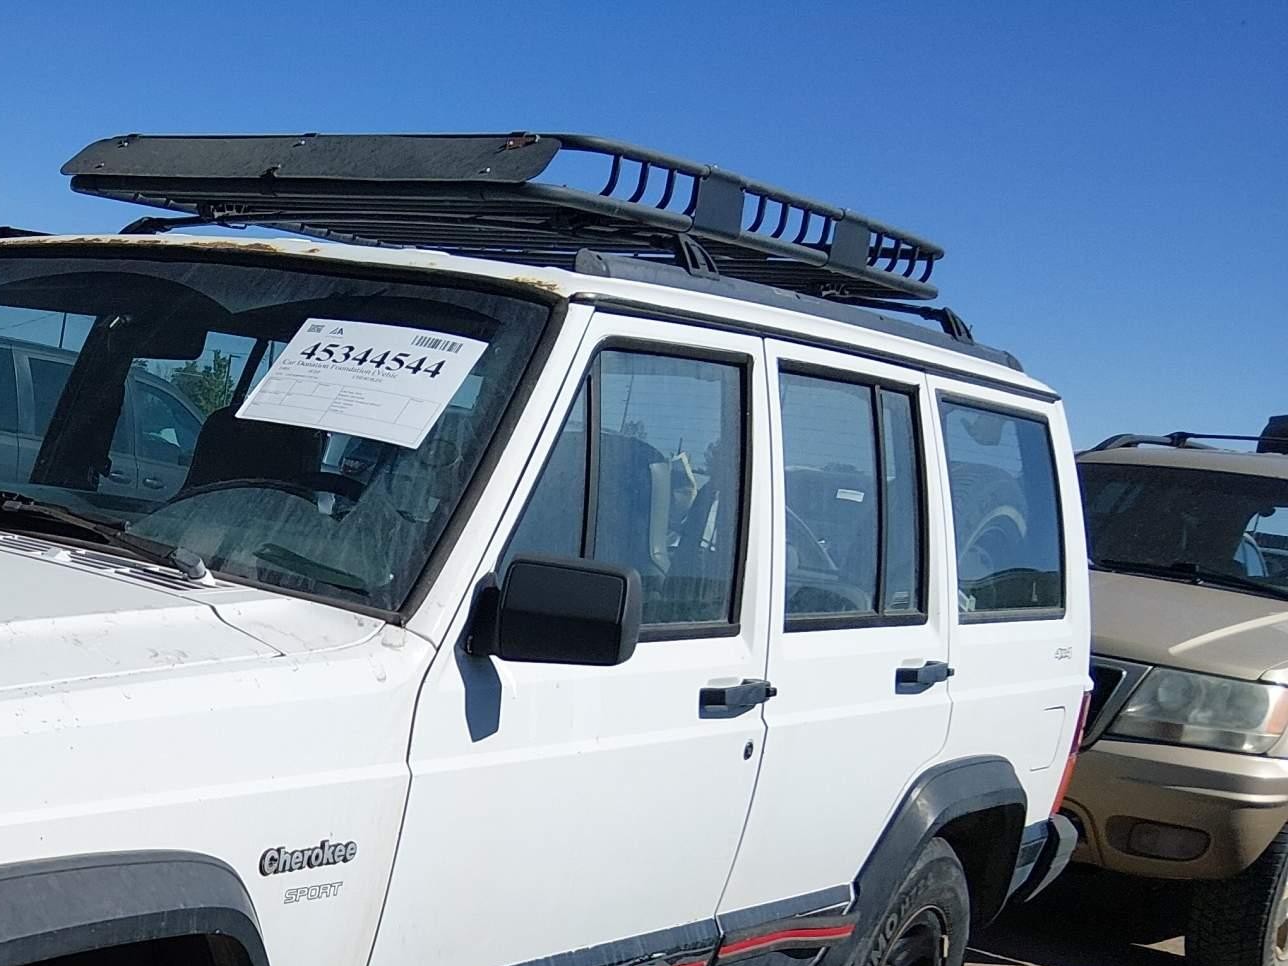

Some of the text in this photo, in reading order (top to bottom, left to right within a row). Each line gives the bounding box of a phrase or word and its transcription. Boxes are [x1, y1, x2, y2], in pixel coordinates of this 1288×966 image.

[300, 341, 446, 379] 45344544
[330, 364, 372, 376] Foundation
[258, 840, 358, 877] Cherokee
[283, 881, 344, 905] SPORT
